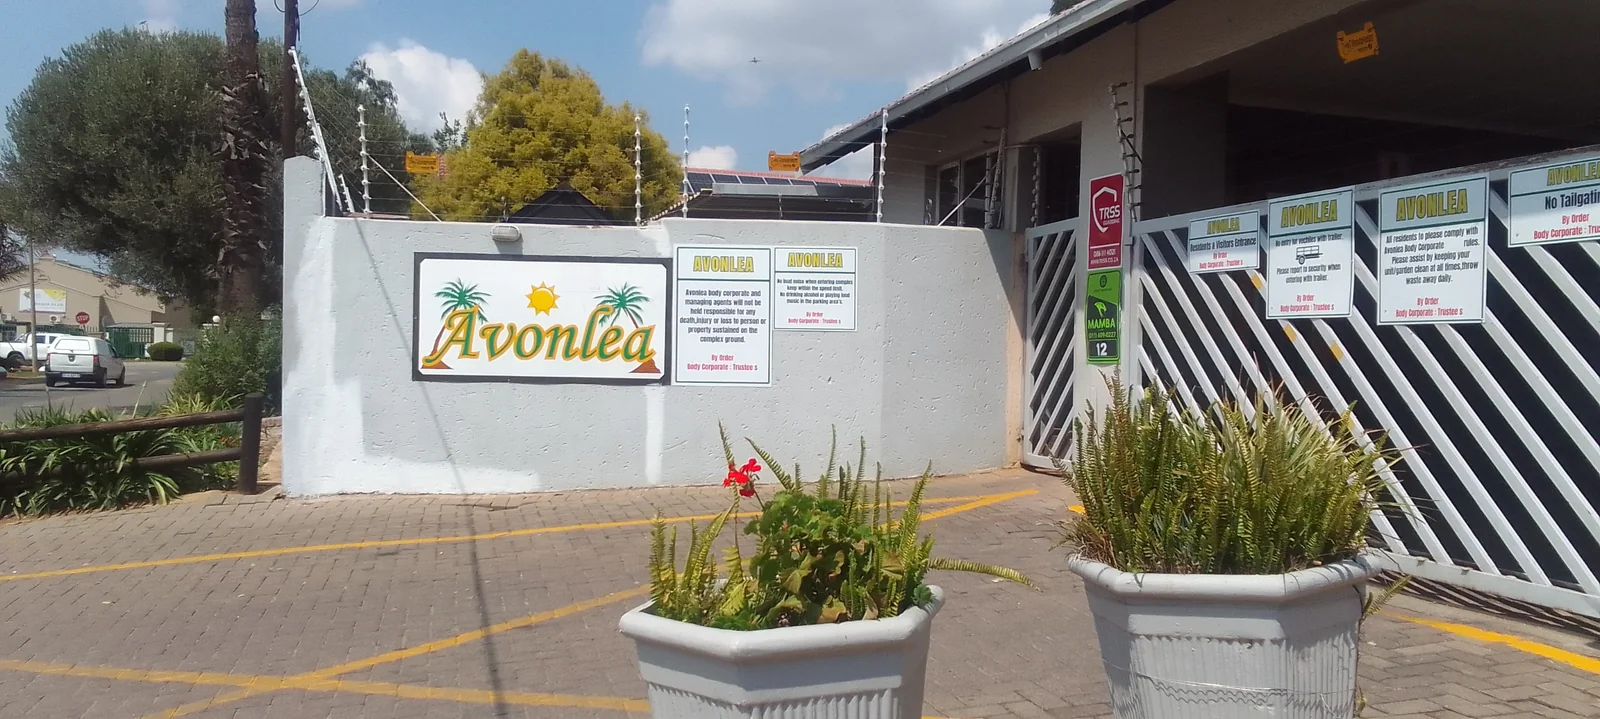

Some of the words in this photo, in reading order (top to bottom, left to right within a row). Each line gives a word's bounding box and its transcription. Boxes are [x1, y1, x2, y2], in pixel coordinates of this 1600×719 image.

[1396, 189, 1468, 221] AVONLEA
[1545, 196, 1557, 210] No
[1099, 205, 1120, 220] TRSS
[1281, 199, 1337, 228] AVONLEA
[1562, 216, 1570, 225] By
[1572, 213, 1589, 223] Order
[1207, 217, 1239, 235] AVONLEA
[1534, 230, 1549, 239] Body
[1551, 227, 1582, 238] Corporate
[1393, 233, 1417, 243] residents
[1425, 231, 1443, 241] please
[1444, 228, 1464, 238] comply
[1466, 226, 1478, 235] with
[1191, 242, 1211, 252] Residents
[1216, 240, 1234, 249] Visitors
[1235, 238, 1256, 247] Entrance
[1385, 246, 1403, 254] Avonlea
[1405, 244, 1417, 253] Body
[1418, 242, 1444, 251] Corporate
[1464, 239, 1479, 247] rules.
[693, 256, 754, 272] AVONLEA
[787, 252, 843, 268] AVONLEA
[1392, 256, 1408, 264] Please
[1409, 255, 1425, 263] assist
[1427, 254, 1433, 262] by
[1435, 252, 1456, 261] keeping
[1457, 251, 1470, 260] your
[1385, 267, 1413, 275] unit/garden
[1414, 265, 1429, 273] clean
[1406, 276, 1421, 285] waste
[1423, 275, 1437, 284] away
[1438, 274, 1453, 282] daily.
[685, 298, 712, 306] managing
[1417, 298, 1423, 306] By
[1425, 297, 1439, 305] Order
[1396, 310, 1407, 318] Body
[1409, 309, 1433, 317] Corporate
[1438, 307, 1458, 316] Trustee
[1088, 318, 1115, 329] MAMBA
[422, 304, 656, 367] Avonlea
[1096, 342, 1107, 356] 12
